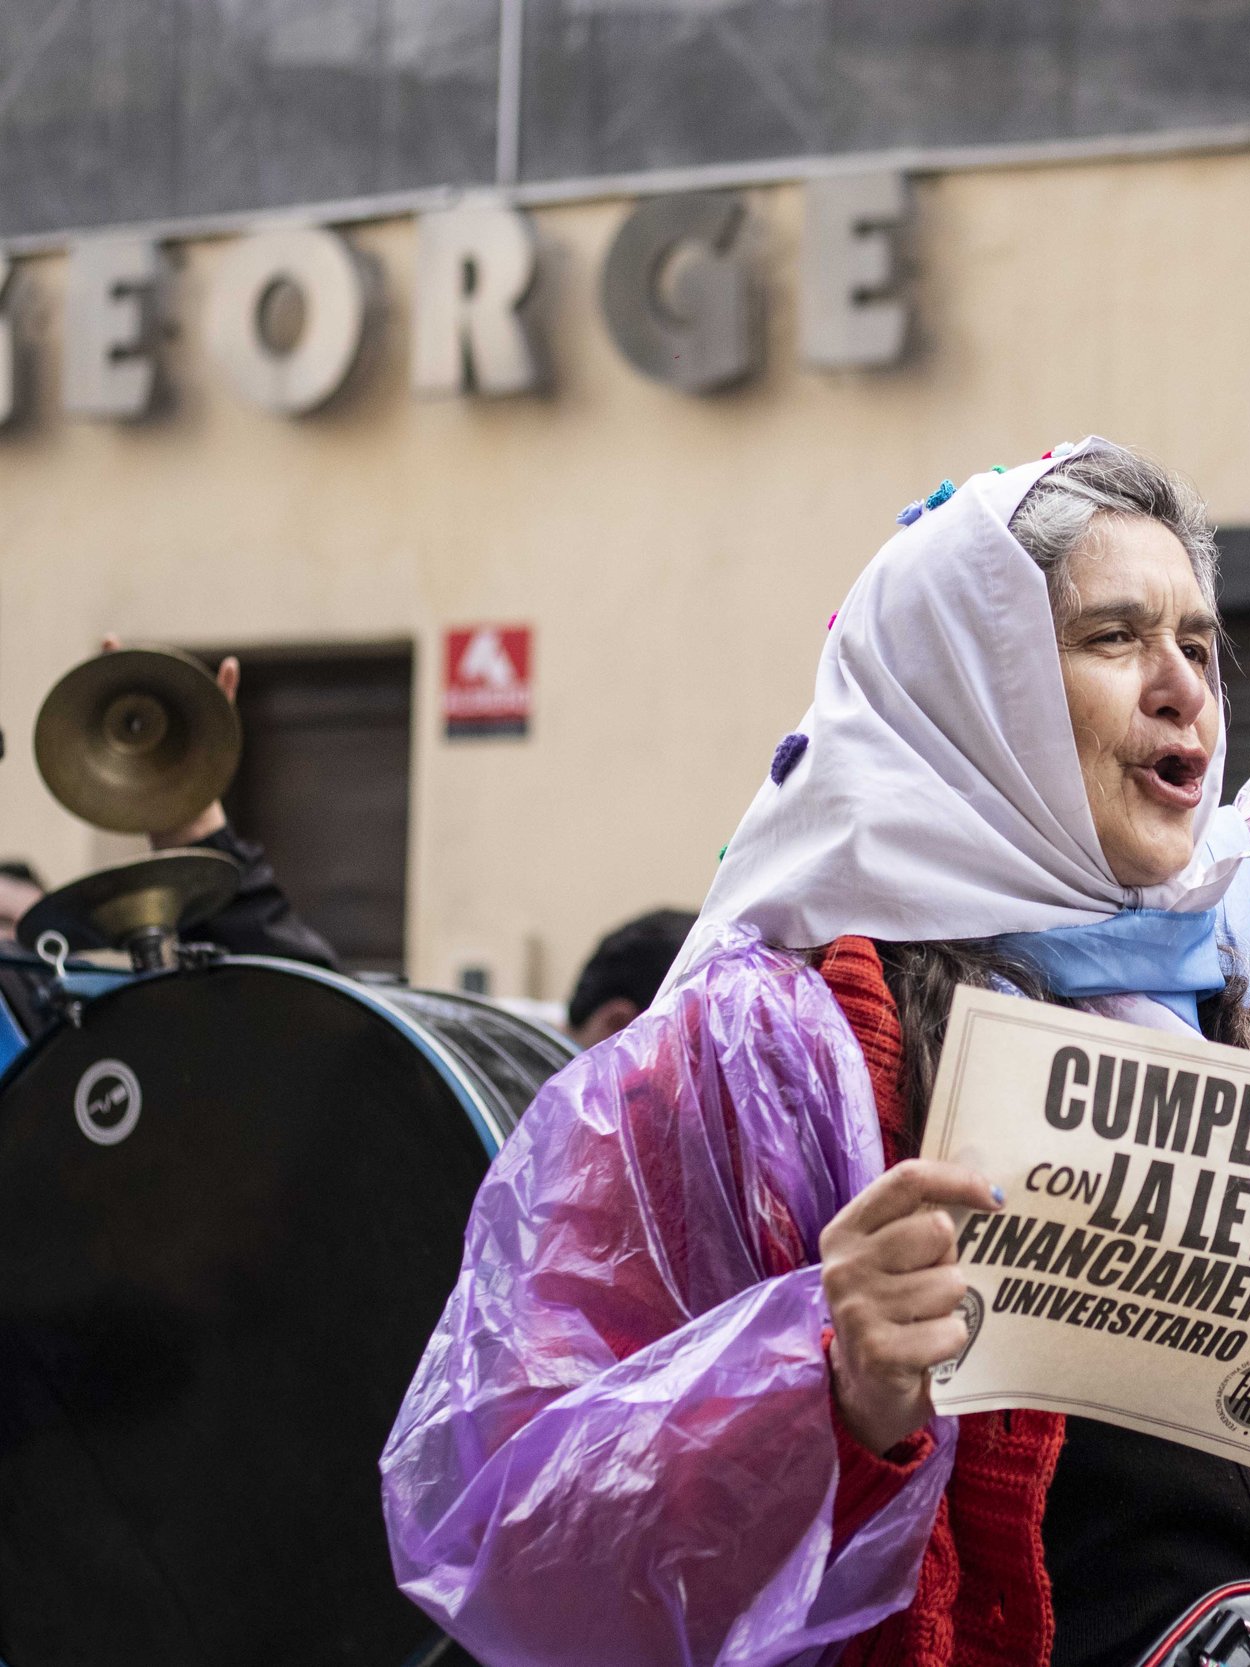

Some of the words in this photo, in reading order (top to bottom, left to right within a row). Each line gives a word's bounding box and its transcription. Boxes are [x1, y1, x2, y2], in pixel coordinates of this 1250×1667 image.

[0, 166, 908, 424] EORGE
[1026, 1162, 1102, 1205] CON
[1088, 1152, 1175, 1242] LA
[991, 1276, 1249, 1364] UNIVERSITARIO
